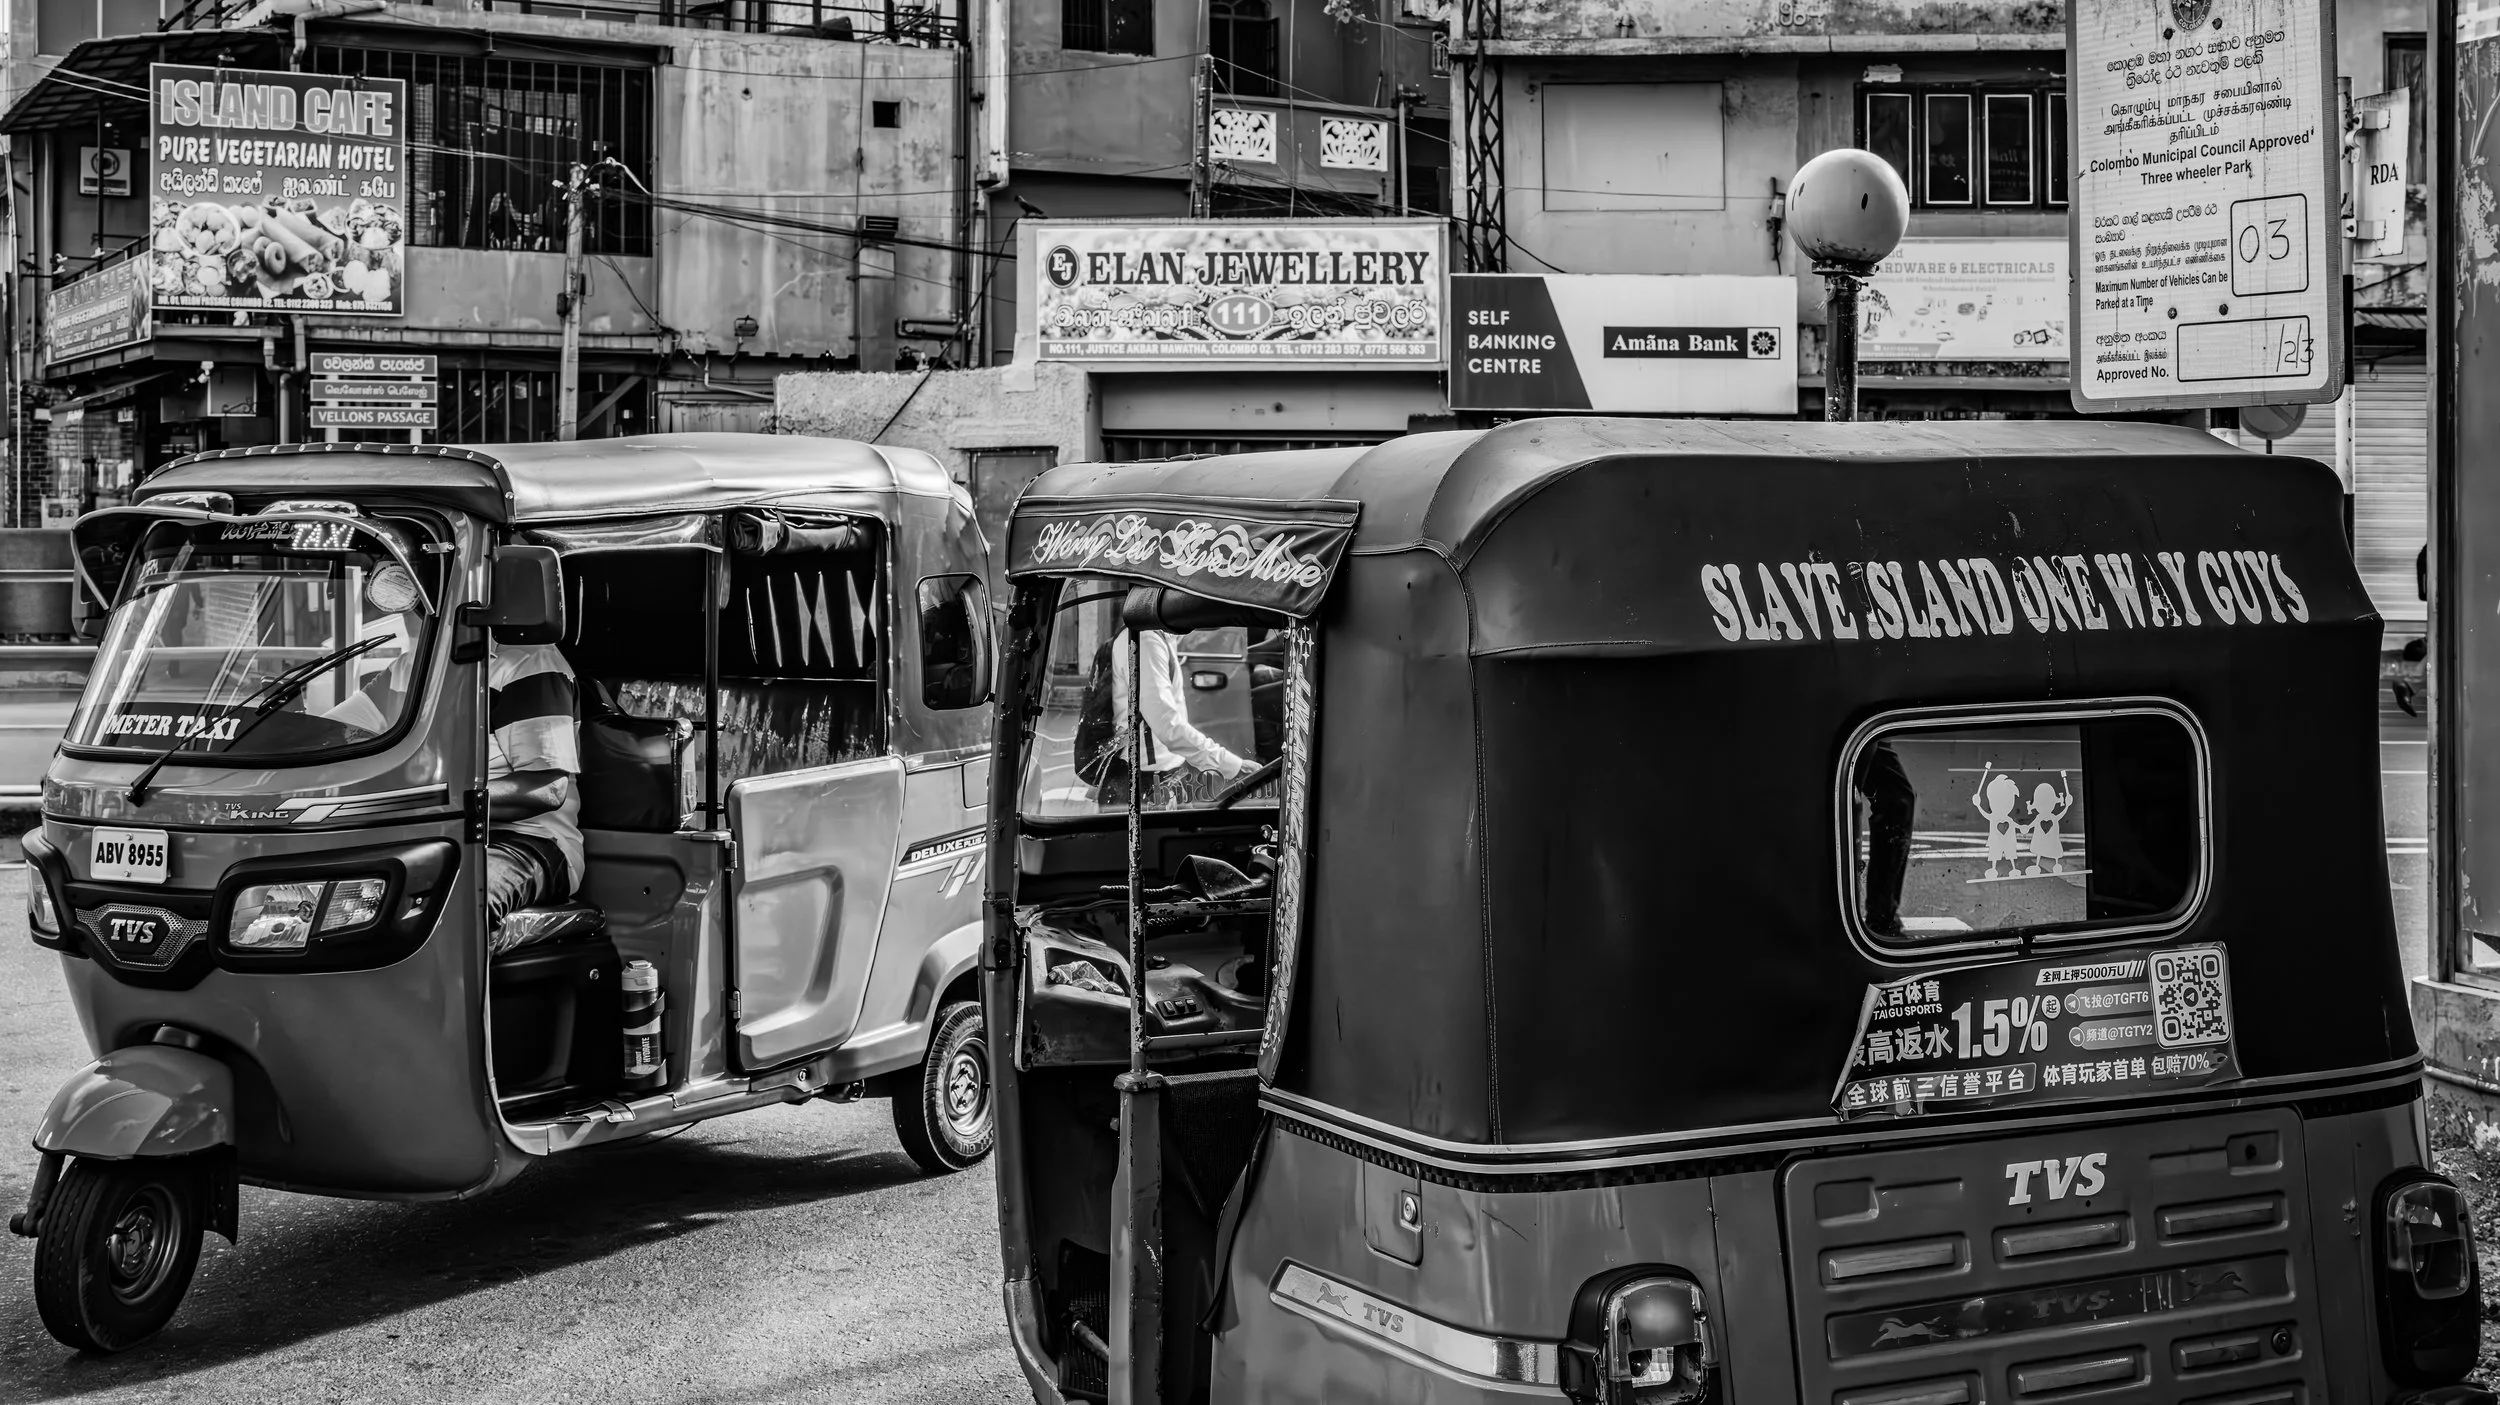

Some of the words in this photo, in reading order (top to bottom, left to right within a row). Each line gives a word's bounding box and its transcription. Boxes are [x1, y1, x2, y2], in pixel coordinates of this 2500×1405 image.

[160, 78, 297, 131] ISLAND
[303, 87, 393, 136] CAFE
[2110, 98, 2161, 118] கொழும்பு
[2213, 77, 2283, 100] சபையினால்
[2169, 121, 2220, 145] தரிப்பிடம்
[159, 135, 211, 164] PURE
[216, 137, 332, 170] VEGETARIAN
[338, 144, 395, 172] HOTEL
[2090, 156, 2140, 173] Colombo
[2142, 146, 2198, 166] Municipal
[2200, 139, 2246, 158] Council
[2248, 131, 2310, 153] Approved
[2141, 171, 2173, 186] Three
[2175, 163, 2222, 180] wheeler
[2225, 158, 2252, 175] Park
[2370, 162, 2399, 186] RDA
[282, 173, 351, 198] ஐலண்ட்
[359, 175, 396, 198] கபே
[2238, 218, 2291, 263] 03
[1086, 251, 1186, 285] ELAN
[1197, 251, 1430, 285] JEWELLERY
[1961, 262, 2056, 274] ELECTRICALS
[2095, 280, 2129, 293] Maximum
[2130, 277, 2159, 290] Number
[2160, 275, 2168, 288] of
[2169, 273, 2200, 287] Vehicles
[2201, 271, 2217, 284] Can
[2218, 270, 2228, 283] be
[1216, 301, 1261, 325] 111
[2095, 297, 2120, 310] Parked
[2121, 298, 2129, 308] at
[2129, 300, 2135, 308] a
[2135, 295, 2154, 307] Time
[1467, 310, 1511, 326] SELF
[1086, 343, 1125, 354] JUSTICE
[1126, 343, 1159, 354] AKBAR
[1160, 344, 1210, 356] MAWATHA,
[1211, 344, 1258, 355] COLOMBO
[1300, 344, 1323, 355] 0712
[1365, 344, 1388, 355] 0775
[1467, 334, 1557, 350] BANKING
[1687, 334, 1739, 352] Bank
[1467, 358, 1542, 374] CENTRE
[2096, 366, 2148, 383] Approved
[2151, 365, 2169, 378] No.
[318, 411, 374, 423] VELLONS
[377, 412, 431, 424] PASSAGE
[291, 523, 356, 548] TAXI
[1228, 532, 1323, 588] More
[1701, 562, 1858, 642] SLAVE
[2011, 553, 2108, 633] ONE
[2094, 551, 2202, 631] WAY
[2198, 549, 2310, 626] GUYS
[105, 714, 173, 736] METER
[175, 715, 242, 740] TAXI
[224, 802, 242, 810] TVS
[95, 841, 125, 865] ABV
[128, 843, 164, 867] 8955
[911, 839, 963, 862] DELUXE
[963, 837, 982, 848] PLUS
[110, 917, 157, 944] TVS
[2042, 964, 2126, 983] 全网上押5000万U
[1873, 1005, 1904, 1021] TAIGU
[1905, 1003, 1943, 1017] SPORTS
[1951, 995, 2048, 1060] 1.5%
[2086, 1025, 2153, 1042] 频道@TGTY2
[641, 1036, 651, 1063] HYDRATE
[2043, 1056, 2147, 1087] 体育玩家首单
[2150, 1052, 2210, 1076] 包赔70%
[1846, 1067, 2026, 1107] 全球前三信誉平台
[2005, 1152, 2107, 1206] TVS
[2029, 1289, 2111, 1319] TVS
[1362, 1301, 1404, 1333] TVS
